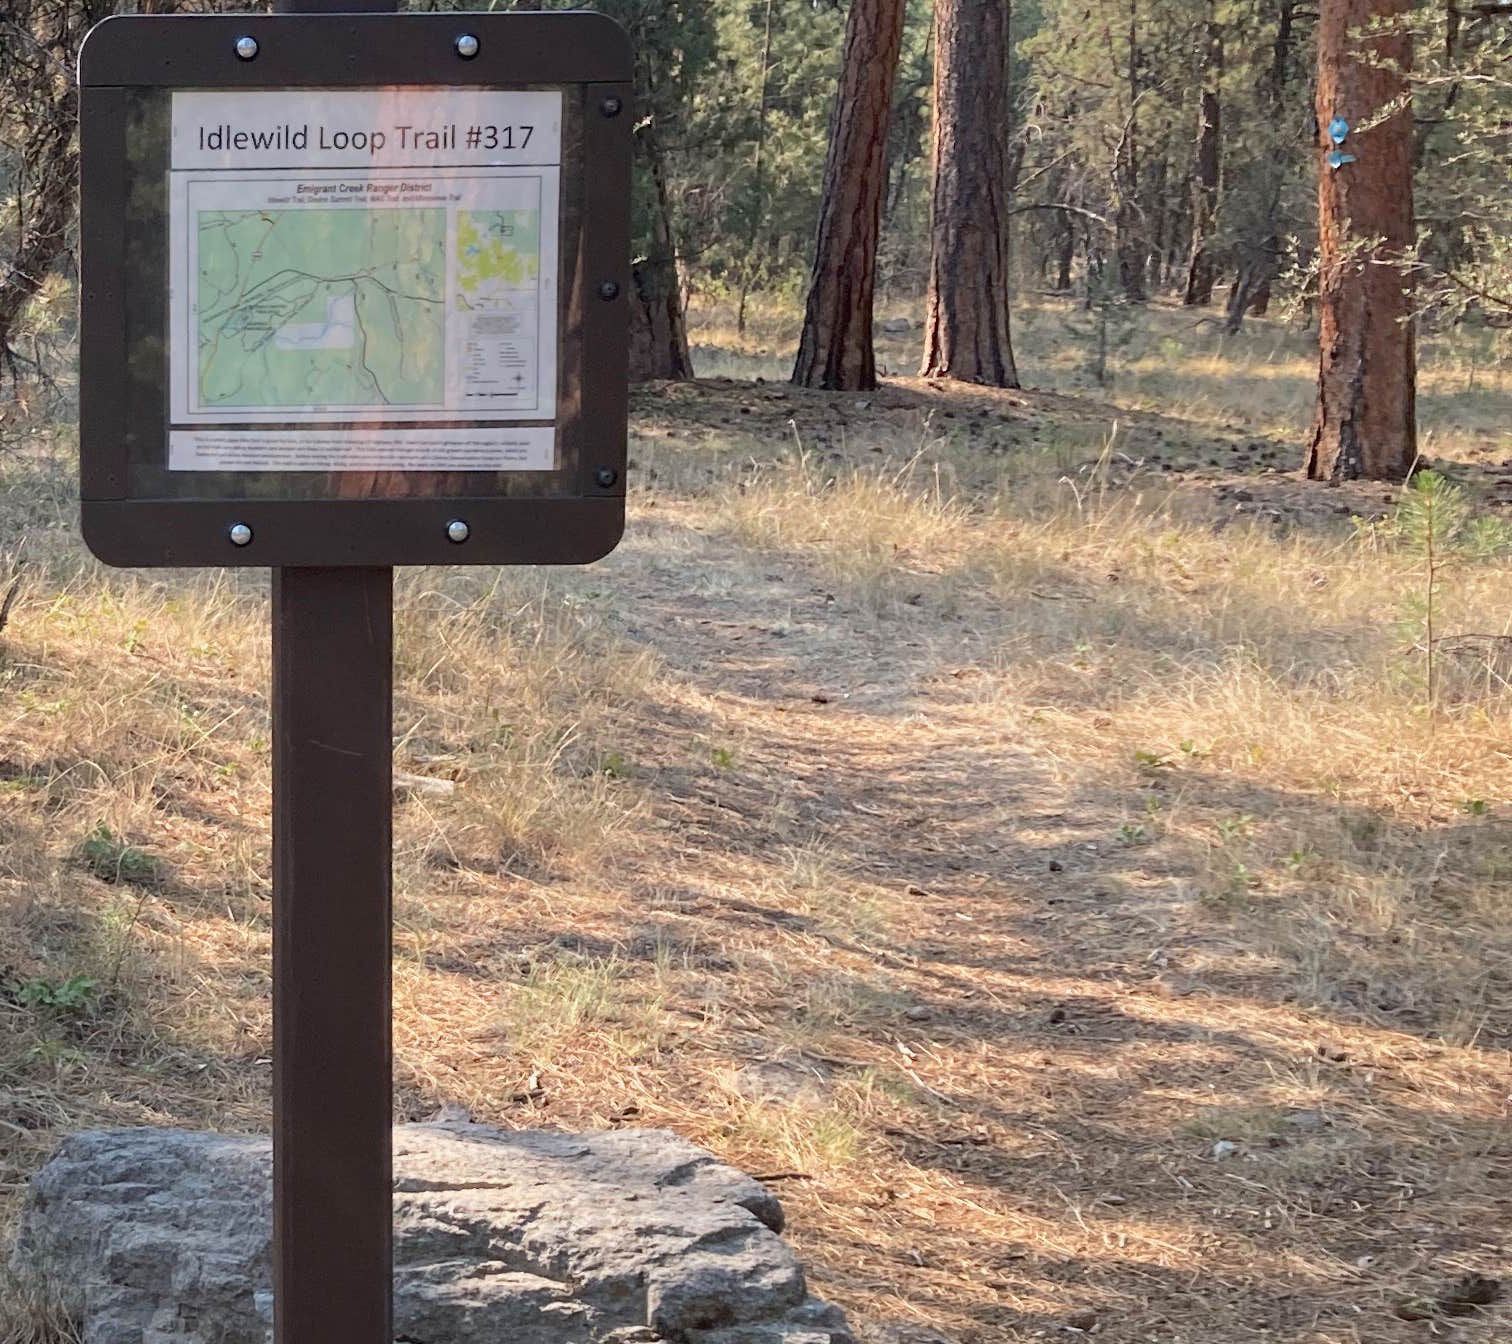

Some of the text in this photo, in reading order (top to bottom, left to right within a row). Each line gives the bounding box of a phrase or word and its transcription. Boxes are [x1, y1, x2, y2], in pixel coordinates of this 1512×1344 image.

[199, 124, 535, 156] Idlewild Loop Trail #317
[296, 182, 433, 196] Emigrant Creek Ranger District
